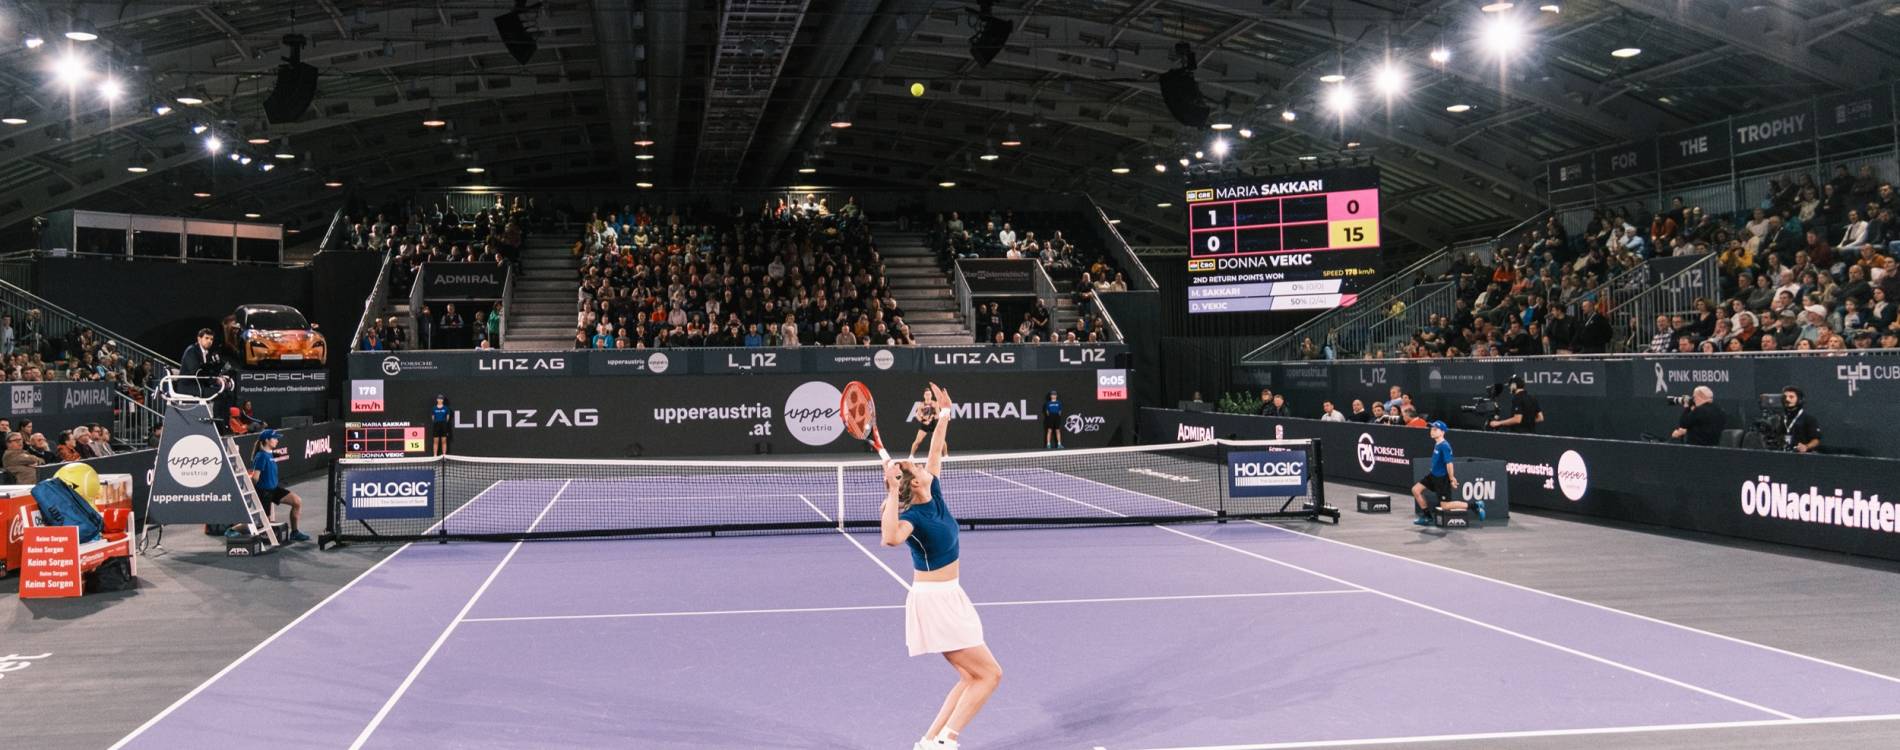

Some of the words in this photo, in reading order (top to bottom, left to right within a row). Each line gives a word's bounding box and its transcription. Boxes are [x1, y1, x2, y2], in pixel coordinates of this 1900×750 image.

[1611, 153, 1638, 171] FOR
[1679, 135, 1708, 157] THE
[1737, 113, 1806, 145] TROPHY
[1216, 185, 1259, 199] MARIA
[1260, 179, 1323, 195] SAKKARI
[1347, 200, 1360, 214] 0
[1208, 210, 1217, 226] 1
[1343, 226, 1364, 242] 15
[1207, 236, 1220, 252] 0
[1218, 256, 1268, 270] DONNA
[1269, 253, 1312, 267] VEKIC
[1192, 276, 1208, 284] 2ND
[1265, 272, 1285, 280] WON
[1322, 269, 1344, 277] SPEED
[1344, 268, 1358, 276] 178
[434, 274, 498, 285] ADMIRAL
[1202, 288, 1241, 296] SAKKARI
[1202, 302, 1228, 310] VEKIC
[478, 358, 529, 371] LINZ
[532, 358, 565, 370] AG
[934, 353, 982, 365] LINZ
[985, 352, 1016, 364] AG
[240, 372, 326, 380] PORSCHE
[1099, 375, 1125, 385] 0:05
[1524, 371, 1563, 384] LINZ
[1566, 371, 1594, 384] AG
[1668, 369, 1690, 383] PINK
[1692, 369, 1729, 383] RIBBON
[358, 386, 377, 395] 178
[1102, 390, 1122, 398] TIME
[13, 391, 32, 404] ORF
[64, 386, 113, 409] ADMIRAL
[354, 401, 381, 410] km/h
[453, 409, 538, 429] LINZ
[545, 408, 599, 427] AG
[653, 402, 772, 424] upperaustria
[784, 408, 841, 423] uppe
[1084, 415, 1106, 424] WTA
[748, 421, 772, 436] .at
[801, 424, 832, 432] austria
[1084, 423, 1100, 432] 250
[304, 434, 332, 459] ADMIRAL
[1373, 445, 1405, 457] PORSCHE
[168, 453, 223, 471] upper
[1234, 461, 1302, 477] HOLOGIC
[1505, 462, 1554, 477] upperaustria
[352, 481, 429, 497] HOLOGIC
[1462, 478, 1496, 501] OÖN
[153, 491, 232, 505] upperaustria.at
[27, 546, 44, 554] Keine
[44, 546, 64, 554] Sorgen
[28, 558, 48, 567] Keine
[48, 558, 74, 567] Sorgen
[25, 580, 46, 588] Keine
[47, 579, 74, 589] Sorgen
